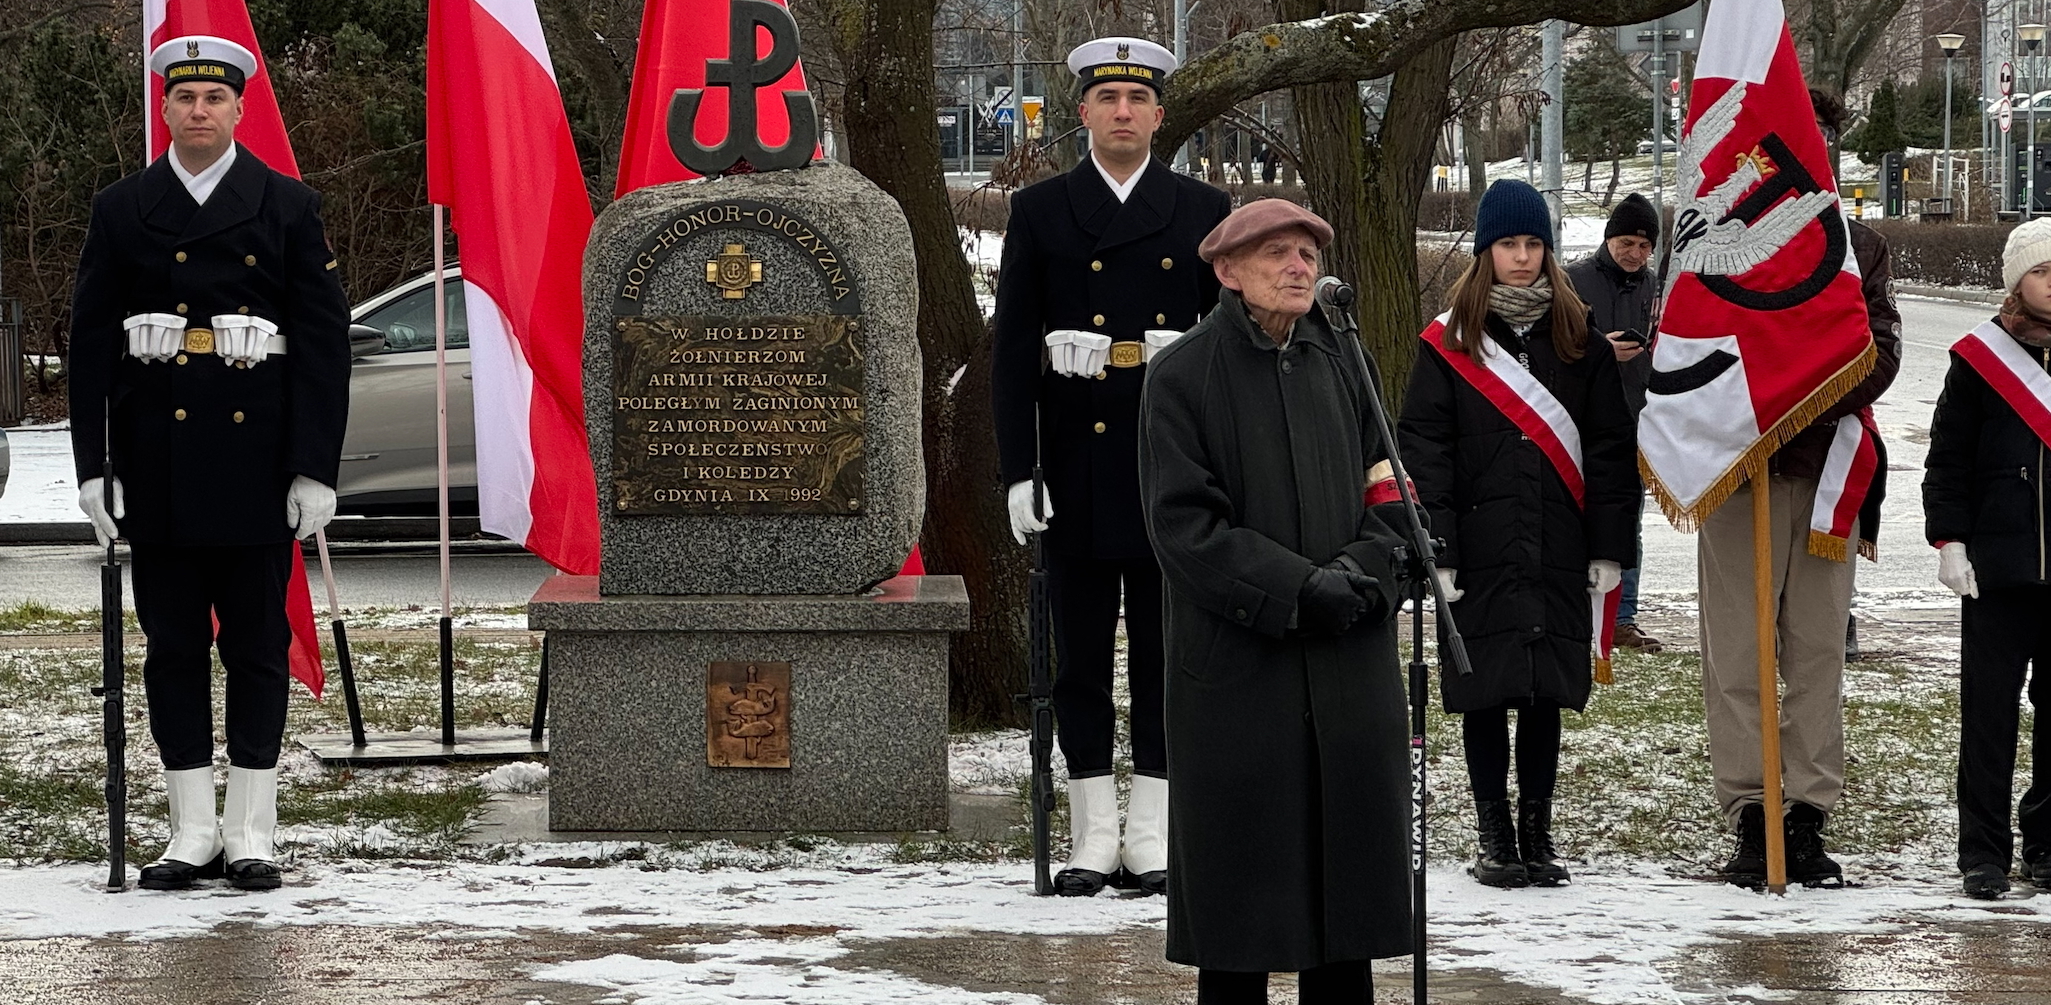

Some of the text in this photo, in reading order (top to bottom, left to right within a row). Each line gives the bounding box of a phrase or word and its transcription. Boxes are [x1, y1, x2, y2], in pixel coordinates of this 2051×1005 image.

[198, 65, 225, 77] WOJENNA
[1094, 66, 1127, 77] MARYNARKA
[671, 327, 806, 341] W HOŁDZIE
[670, 349, 806, 363] ŻOŁNIERZOM
[648, 373, 828, 387] ARMII KRAJOWEJ
[617, 396, 859, 411] POLEGŁYM ZAGINIONYM
[648, 419, 828, 433] ZAMORDOWANYM
[648, 441, 828, 456] SPOŁECZEŃSTWO
[683, 466, 795, 480] I KOLEDZY
[654, 487, 822, 502] GDYNIA IX 1992
[1412, 748, 1422, 871] DYNAWID
